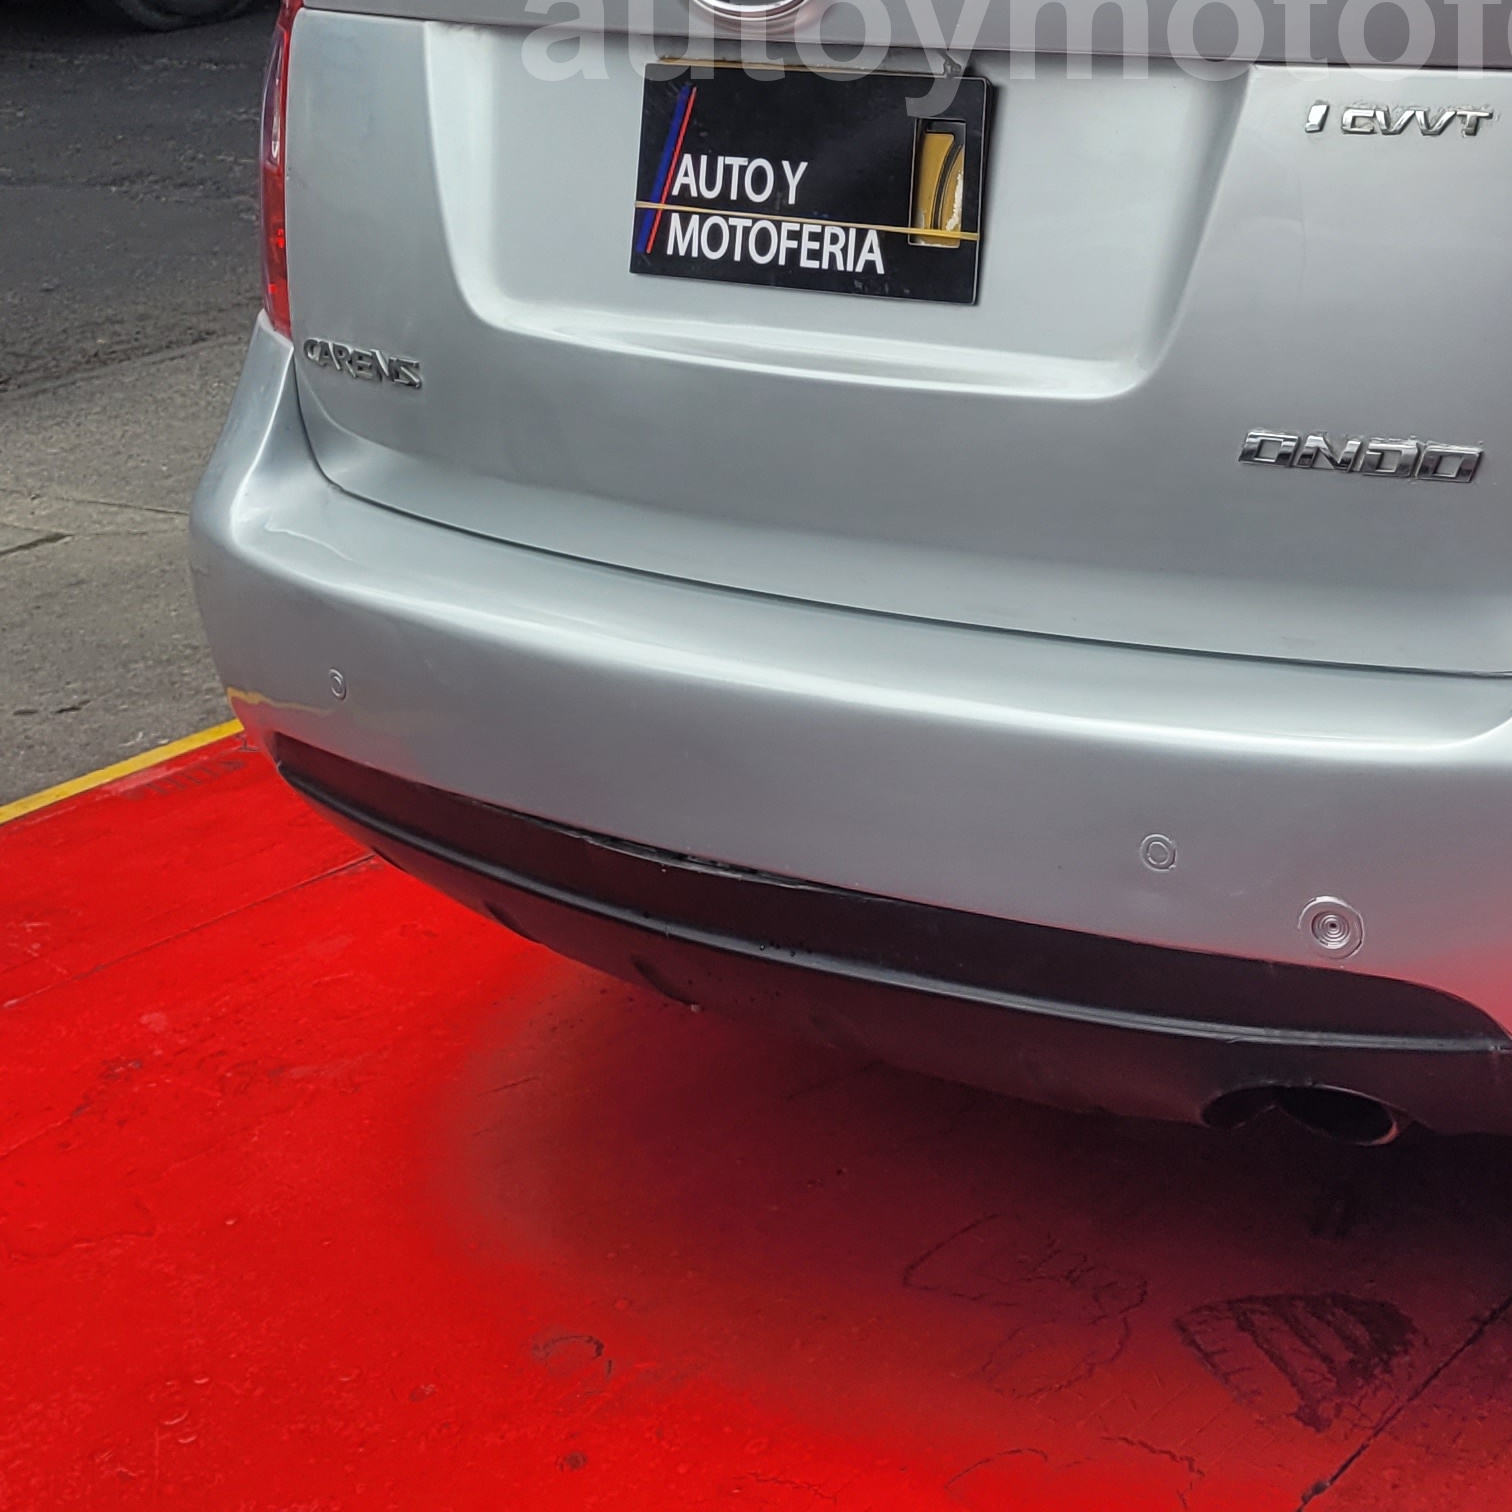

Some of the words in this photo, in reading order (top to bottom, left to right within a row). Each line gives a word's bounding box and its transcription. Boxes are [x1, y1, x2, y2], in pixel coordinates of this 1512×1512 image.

[671, 153, 775, 203] AUTO
[781, 160, 809, 205] Y
[666, 212, 885, 275] MOTOFERIA
[303, 338, 423, 389] CARENS
